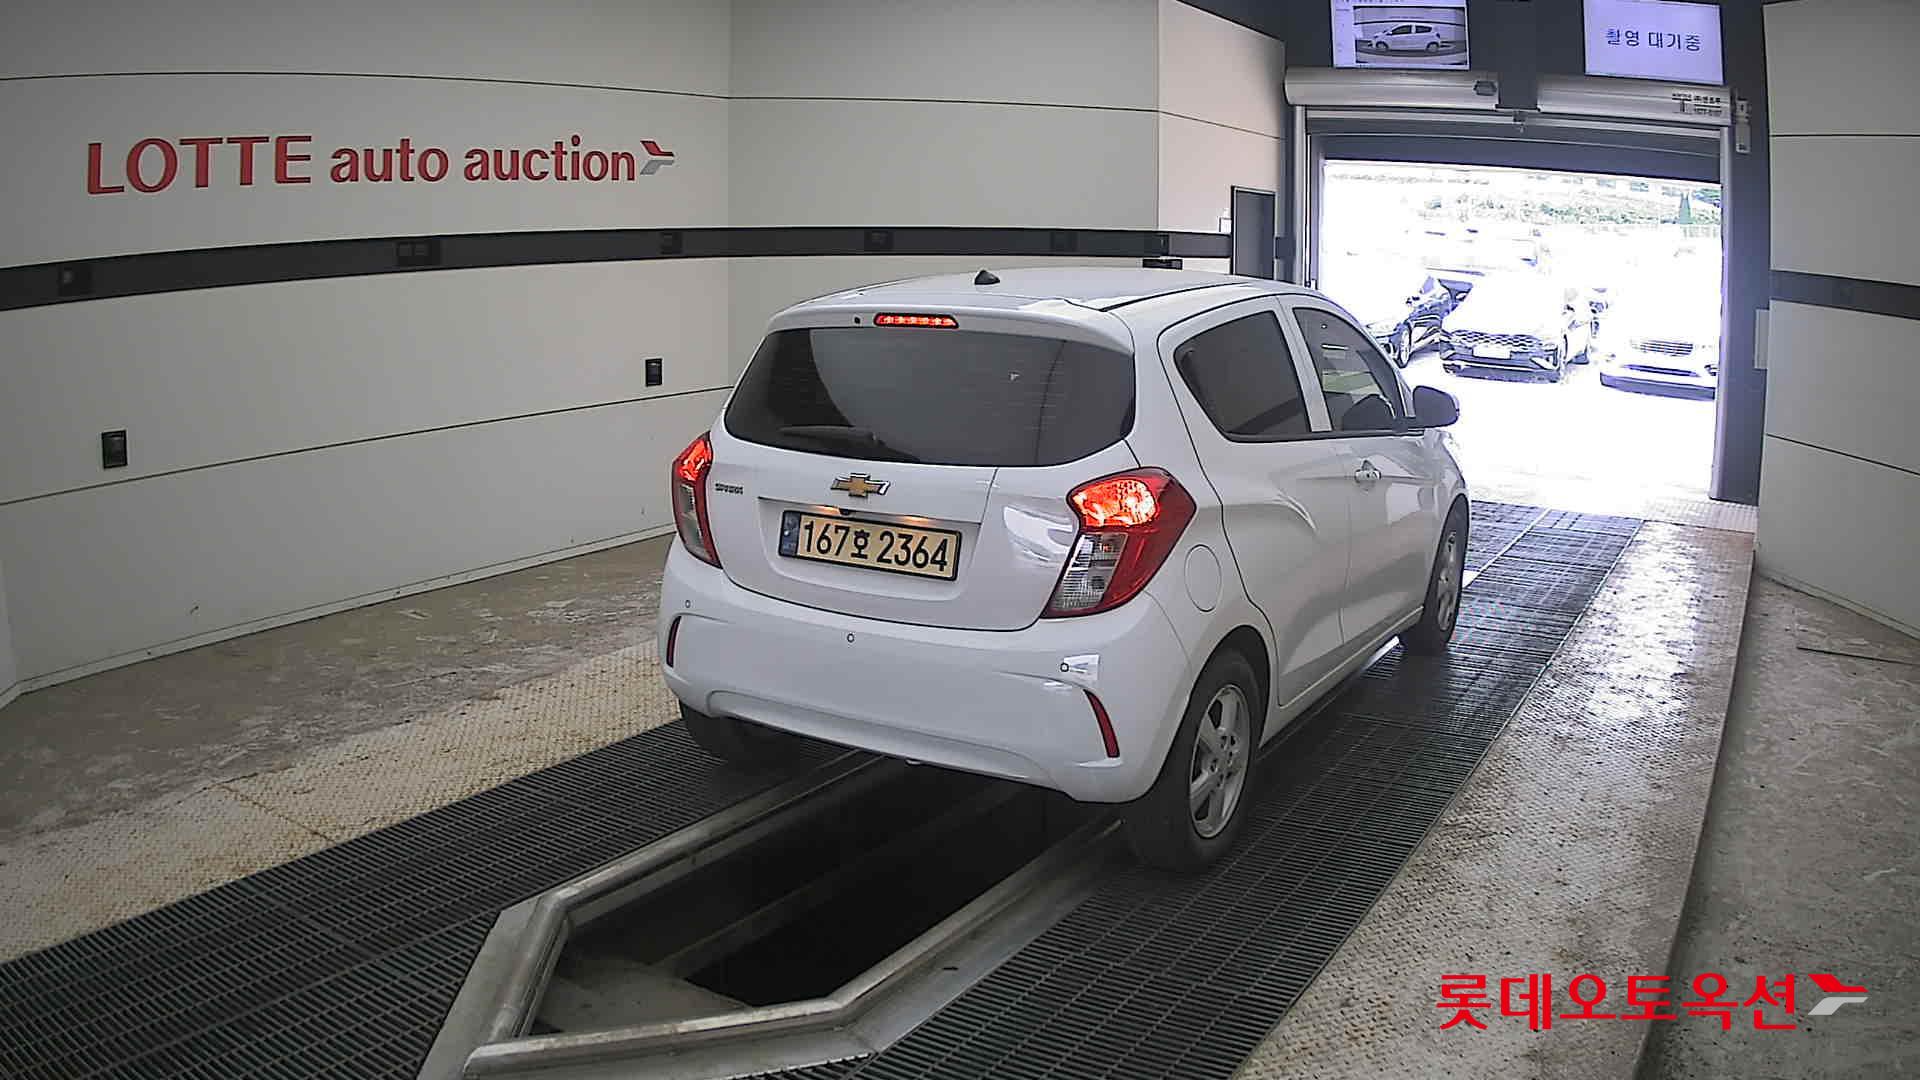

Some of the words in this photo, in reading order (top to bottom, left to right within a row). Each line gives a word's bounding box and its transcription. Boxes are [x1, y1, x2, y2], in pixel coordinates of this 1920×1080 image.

[1648, 31, 1701, 52] 대기중
[87, 135, 312, 195] LOTTE
[329, 138, 449, 183] auto
[463, 134, 636, 182] auction
[804, 520, 870, 560] 167호
[876, 530, 949, 572] 2364
